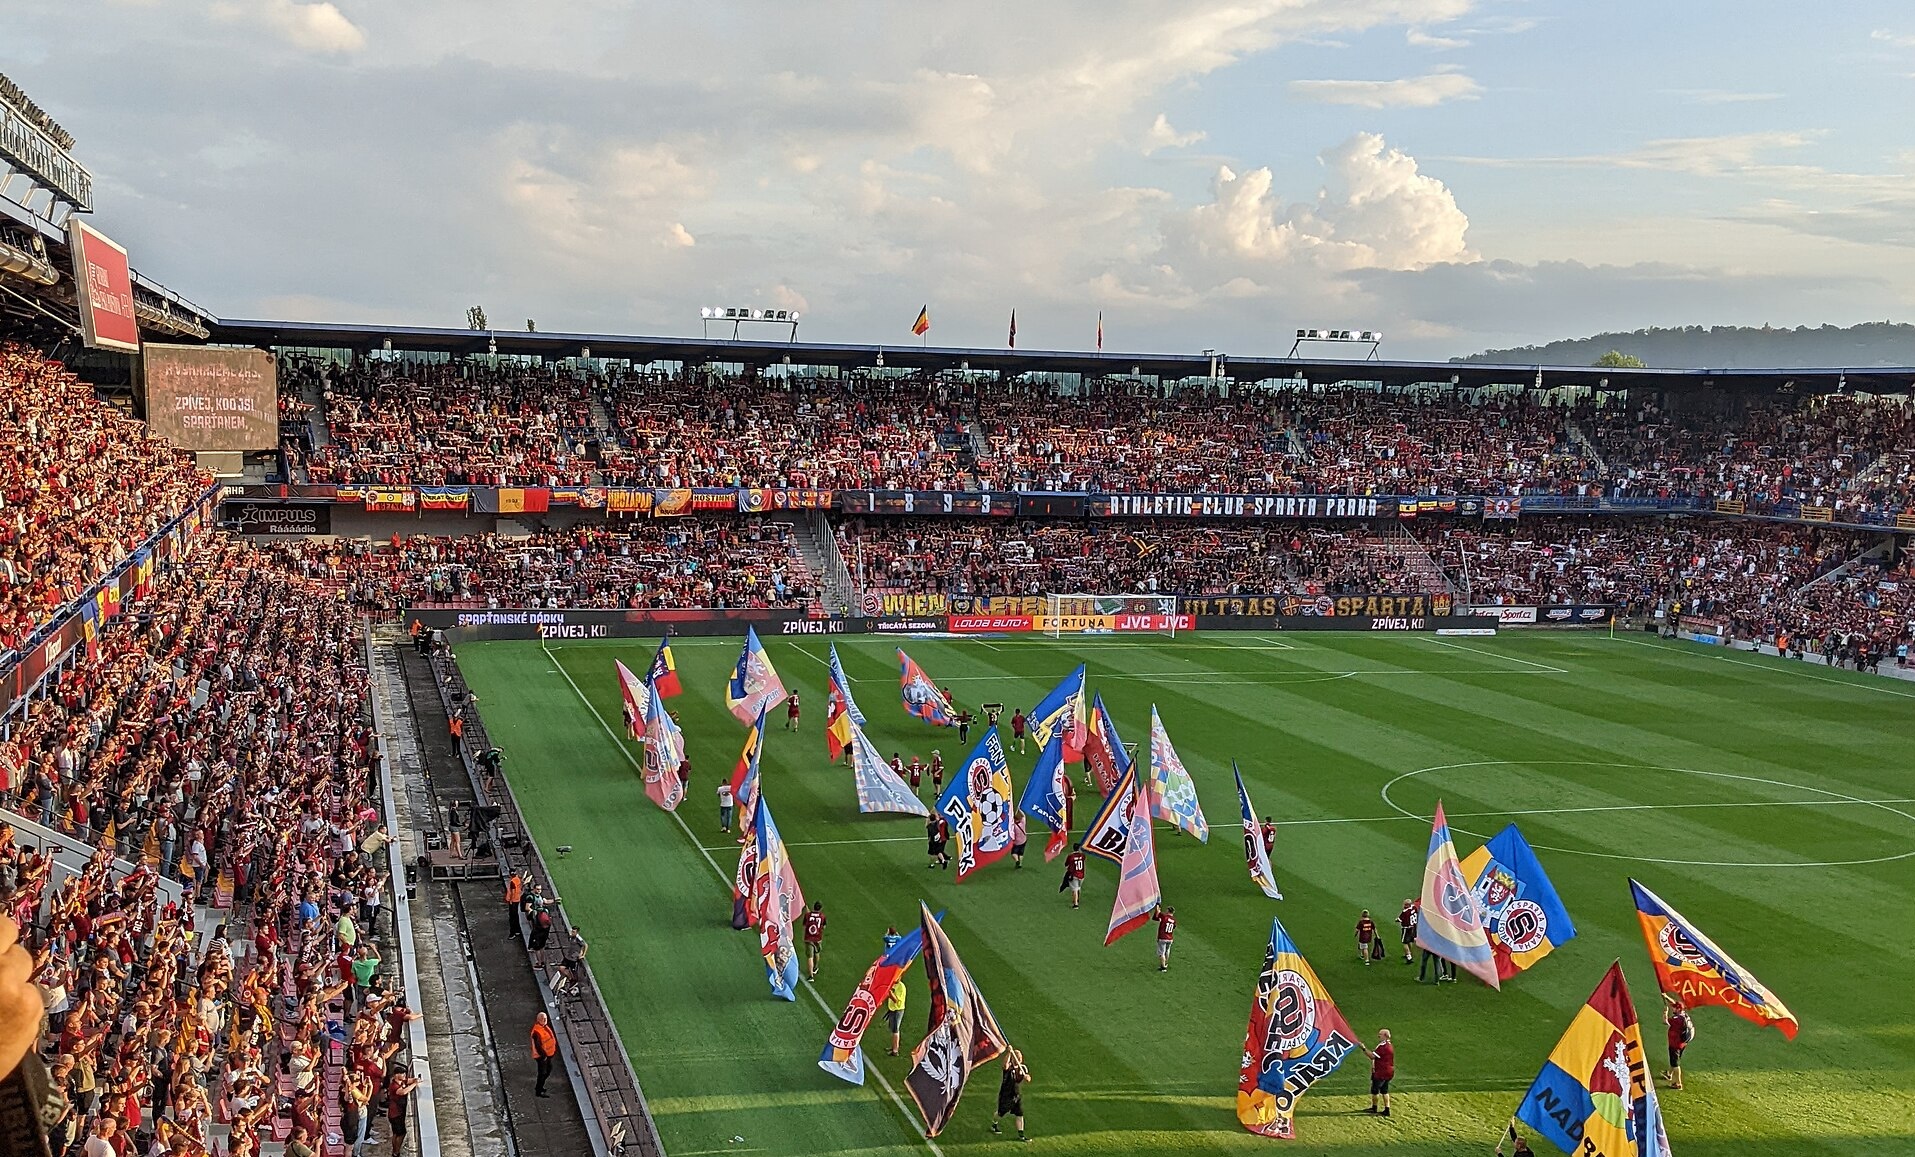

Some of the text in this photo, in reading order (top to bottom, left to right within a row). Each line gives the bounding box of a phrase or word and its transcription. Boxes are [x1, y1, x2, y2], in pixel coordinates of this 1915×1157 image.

[869, 493, 875, 512] 1
[904, 493, 914, 512] 8
[1110, 496, 1378, 517] ATHLETIC CLUB SPARTA PRAHA
[259, 509, 317, 523] IMPULS
[270, 523, 316, 533] Ráááádio
[1337, 595, 1425, 616] SPARTA
[783, 619, 827, 634] ZPÍVEJ,
[1043, 618, 1105, 628] FORTUNA
[1121, 616, 1150, 629] JVC
[1159, 616, 1188, 629] JVC
[1371, 617, 1410, 630] ZPÍVEJ,
[542, 623, 588, 638] ZPÍVEJ,
[1074, 860, 1083, 871] 10
[1165, 922, 1174, 933] 10
